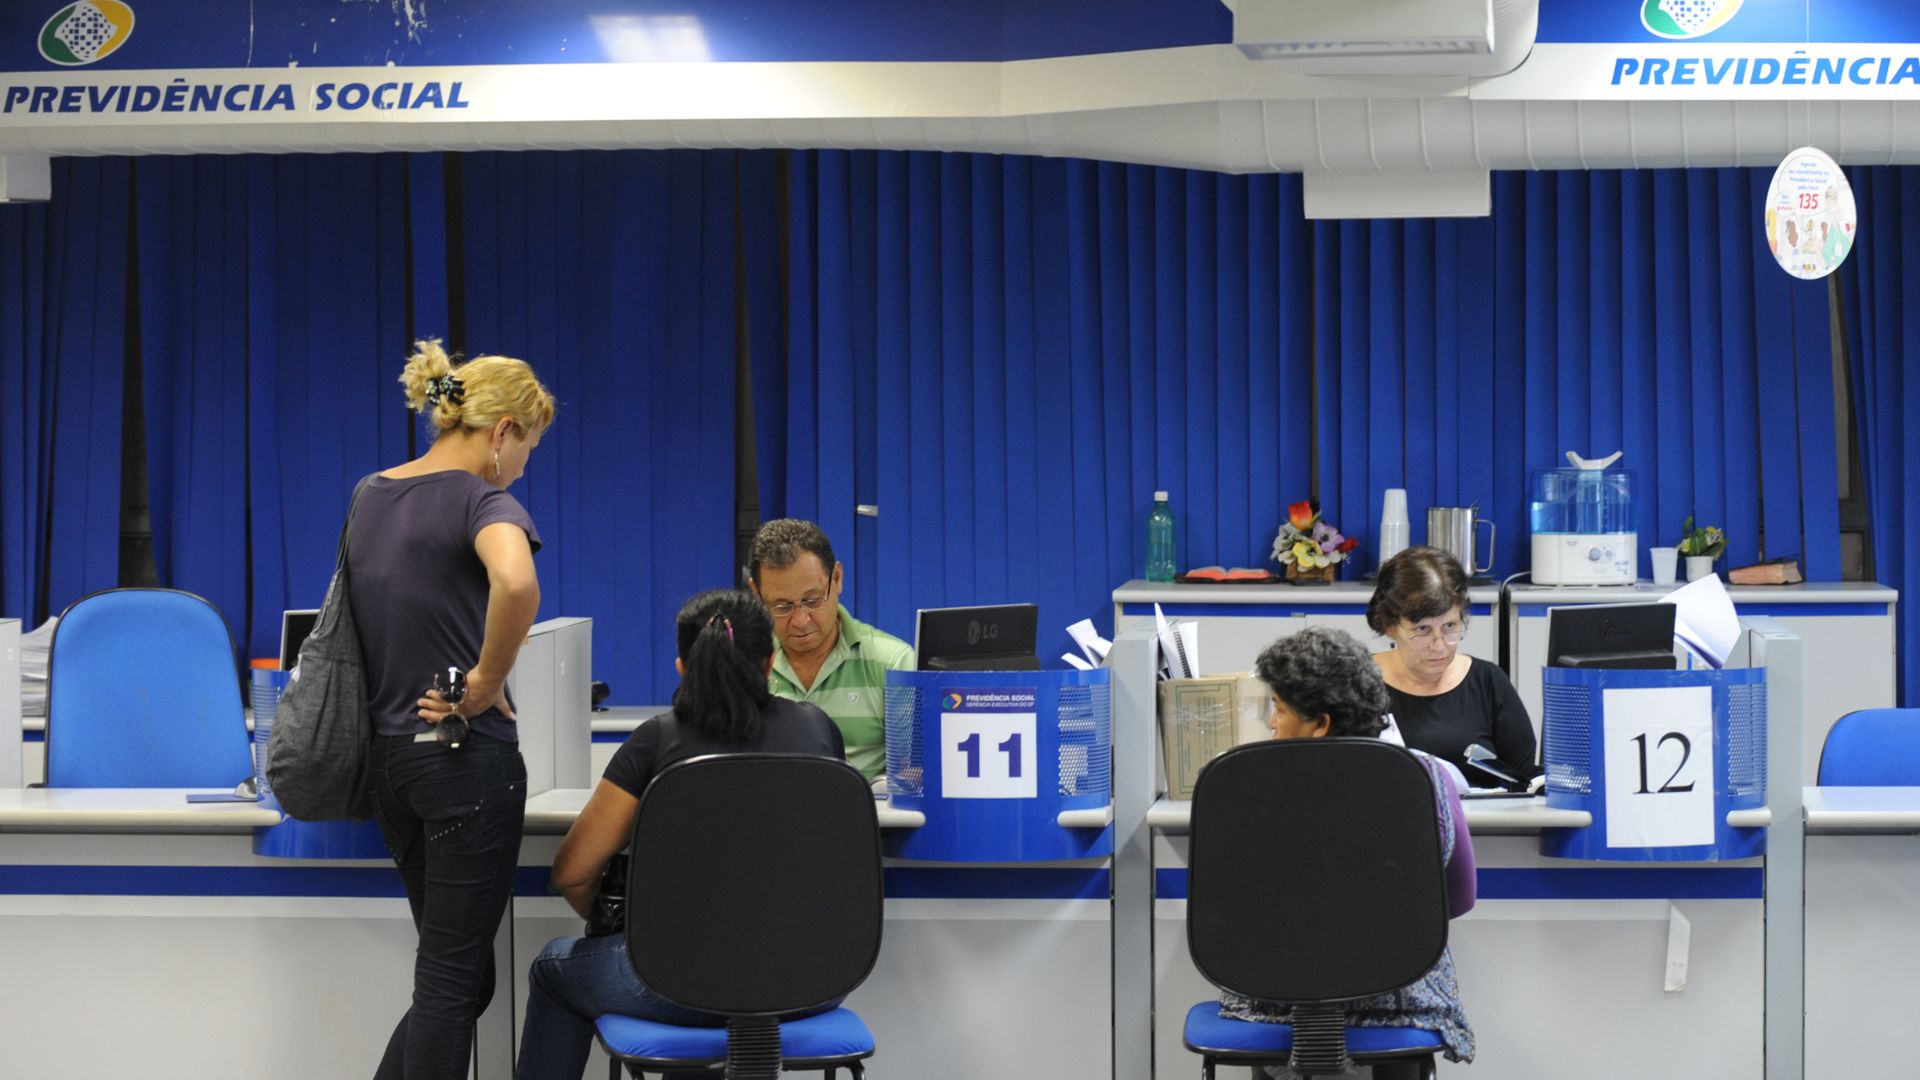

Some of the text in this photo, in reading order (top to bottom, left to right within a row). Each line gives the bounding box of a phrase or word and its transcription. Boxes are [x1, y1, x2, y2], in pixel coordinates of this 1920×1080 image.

[1610, 50, 1920, 85] PREVIDÊNCIA
[3, 78, 470, 113] PREVIDÊNCIA SOCIAL
[1798, 193, 1819, 209] 135
[982, 623, 998, 638] LG
[966, 693, 1036, 702] PREVIDÊNCIA SOCIAL
[957, 733, 1021, 778] 11
[1630, 731, 1696, 795] 12
